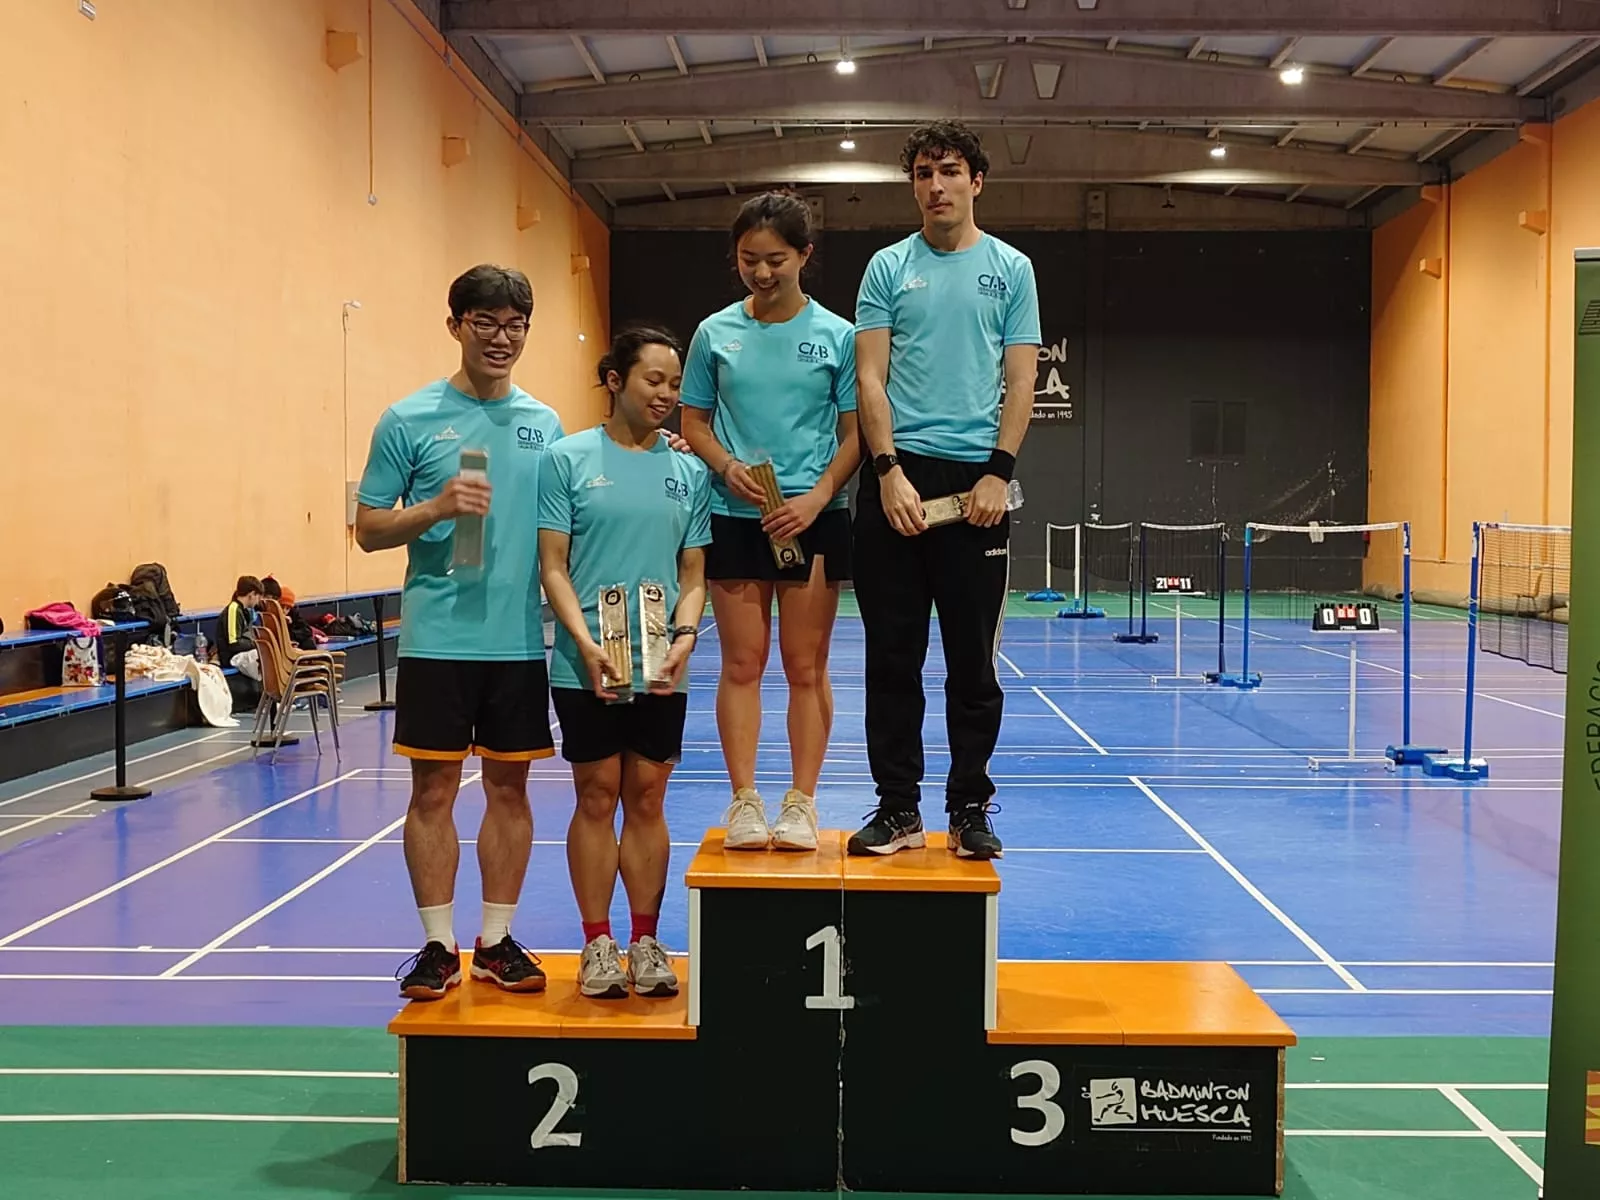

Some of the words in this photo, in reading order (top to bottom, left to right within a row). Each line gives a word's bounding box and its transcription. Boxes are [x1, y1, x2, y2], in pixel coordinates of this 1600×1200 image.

[1156, 577, 1168, 589] 21
[1322, 608, 1335, 625] 0
[1359, 608, 1371, 625] 0
[805, 925, 855, 1009] 1
[528, 1062, 582, 1149] 2
[1010, 1059, 1066, 1147] 3
[1140, 1103, 1251, 1127] HUESCA
